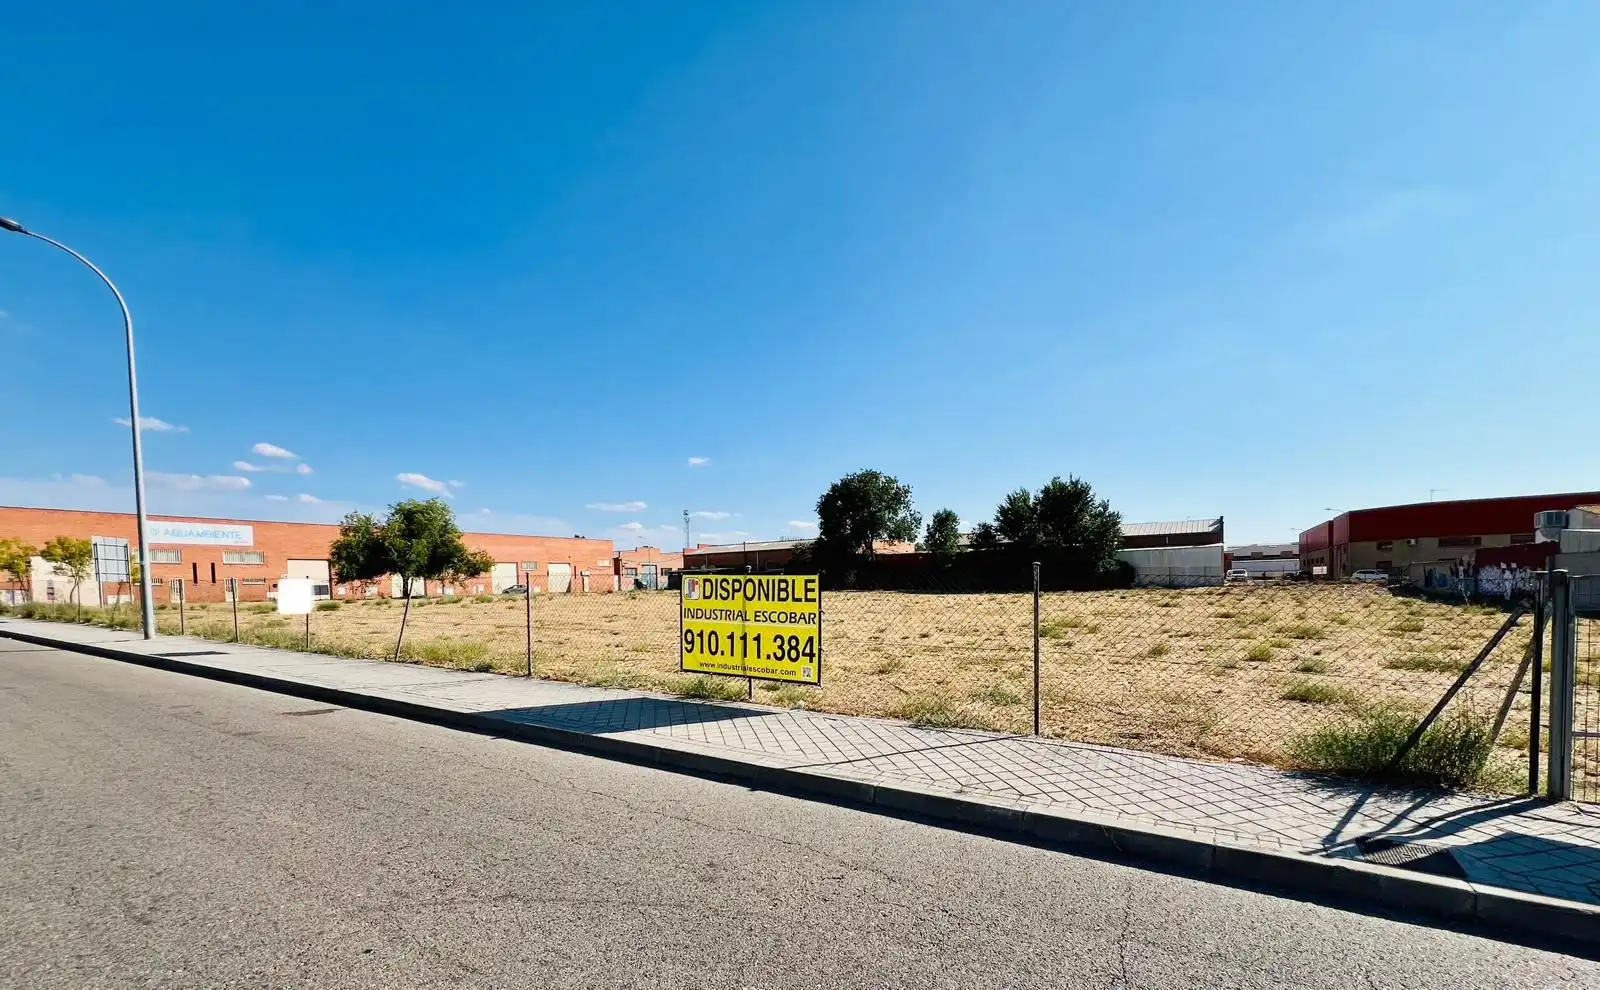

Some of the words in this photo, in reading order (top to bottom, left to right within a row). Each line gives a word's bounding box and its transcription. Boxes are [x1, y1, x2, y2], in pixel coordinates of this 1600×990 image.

[702, 578, 817, 603] DISPONIBLE
[684, 607, 750, 622] INDUSTRIAL
[754, 610, 817, 625] ESCOBAR
[684, 628, 816, 664] 910.111.384
[699, 661, 797, 677] www.industrialescobar.com
